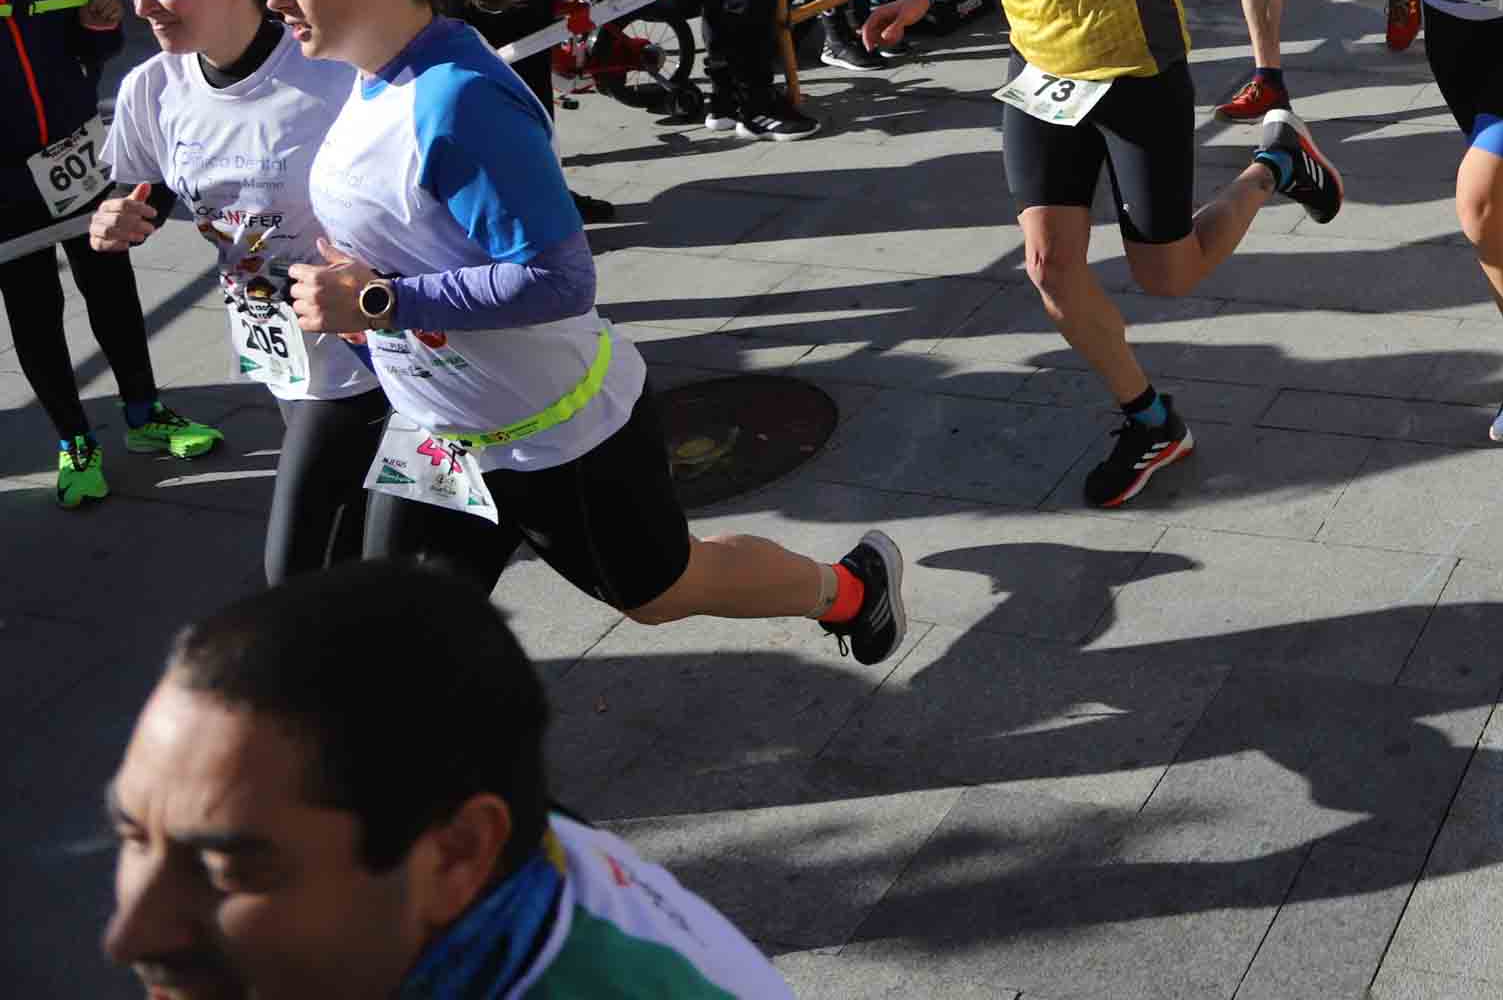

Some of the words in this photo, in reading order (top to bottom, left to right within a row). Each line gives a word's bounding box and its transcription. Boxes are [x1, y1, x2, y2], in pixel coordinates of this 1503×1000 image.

[1034, 74, 1076, 102] 73
[49, 140, 97, 192] 607
[241, 318, 289, 359] 205
